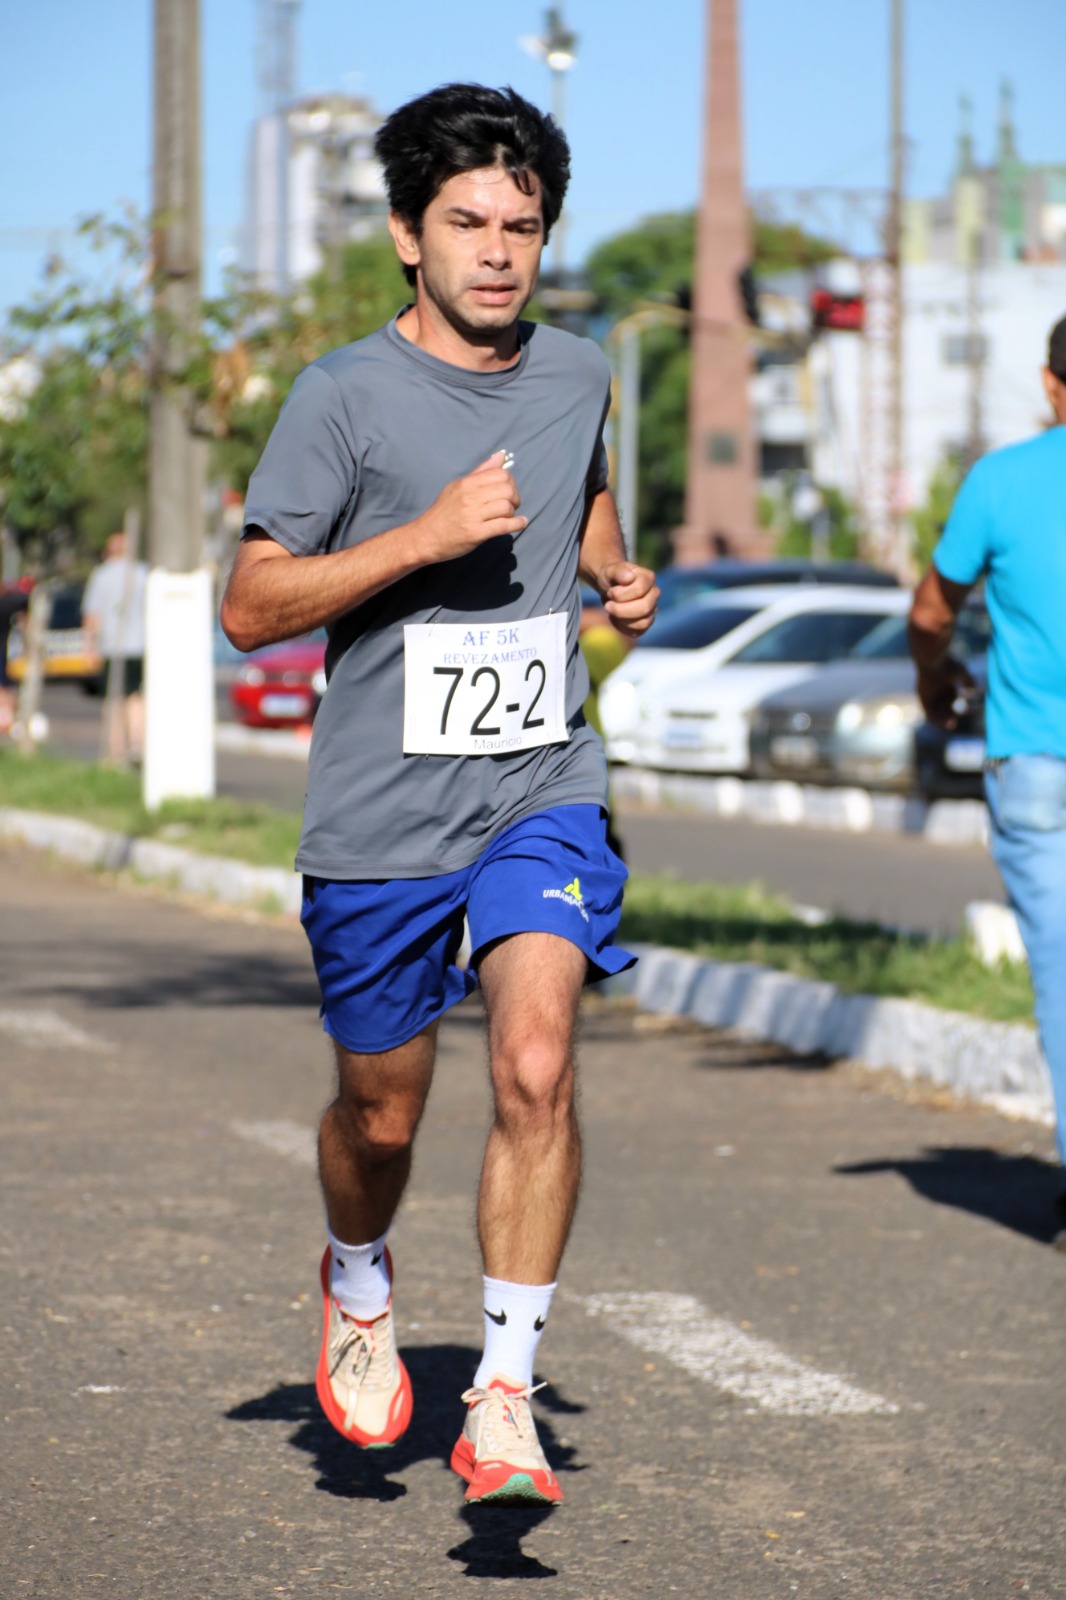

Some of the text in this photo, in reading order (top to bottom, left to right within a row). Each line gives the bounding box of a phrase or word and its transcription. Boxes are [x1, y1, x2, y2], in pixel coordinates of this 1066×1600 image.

[462, 628, 520, 646] AF 5K
[443, 647, 537, 664] REVEZAMENTO
[433, 659, 546, 736] 72-2
